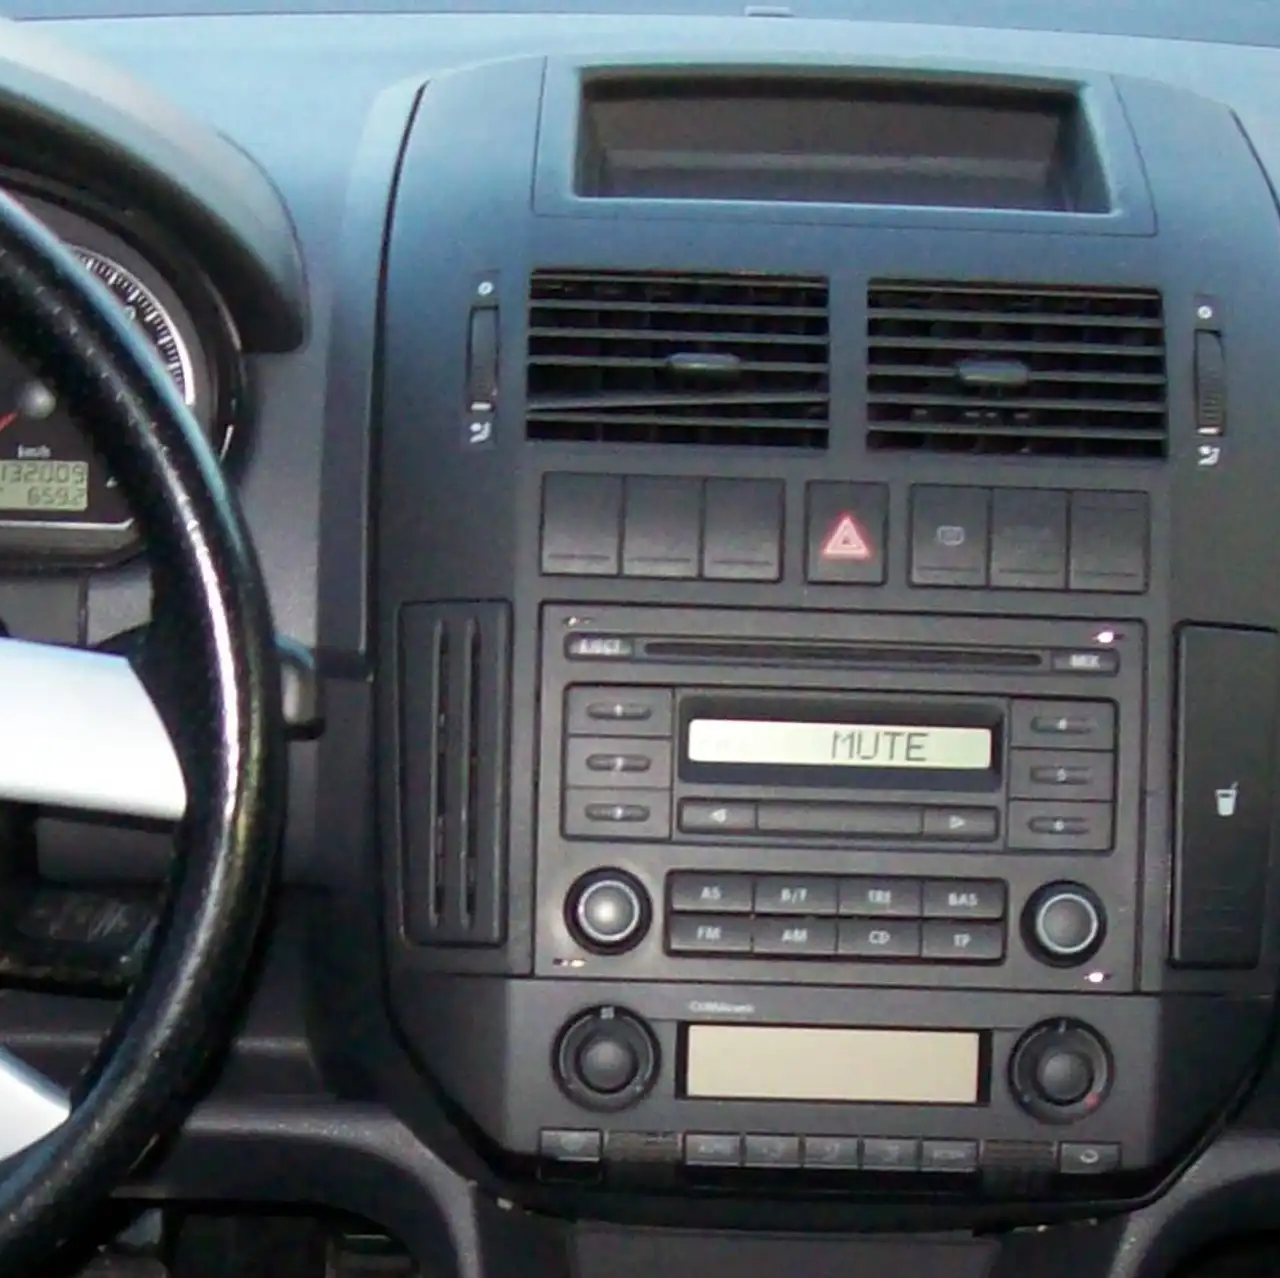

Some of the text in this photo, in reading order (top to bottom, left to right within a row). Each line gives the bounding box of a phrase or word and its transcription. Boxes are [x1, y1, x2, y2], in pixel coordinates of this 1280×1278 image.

[830, 729, 929, 762] MUTE
[700, 886, 722, 901] AS
[947, 892, 979, 907] BAS
[696, 925, 721, 940] FM
[781, 928, 808, 943] AM
[867, 929, 892, 945] CD
